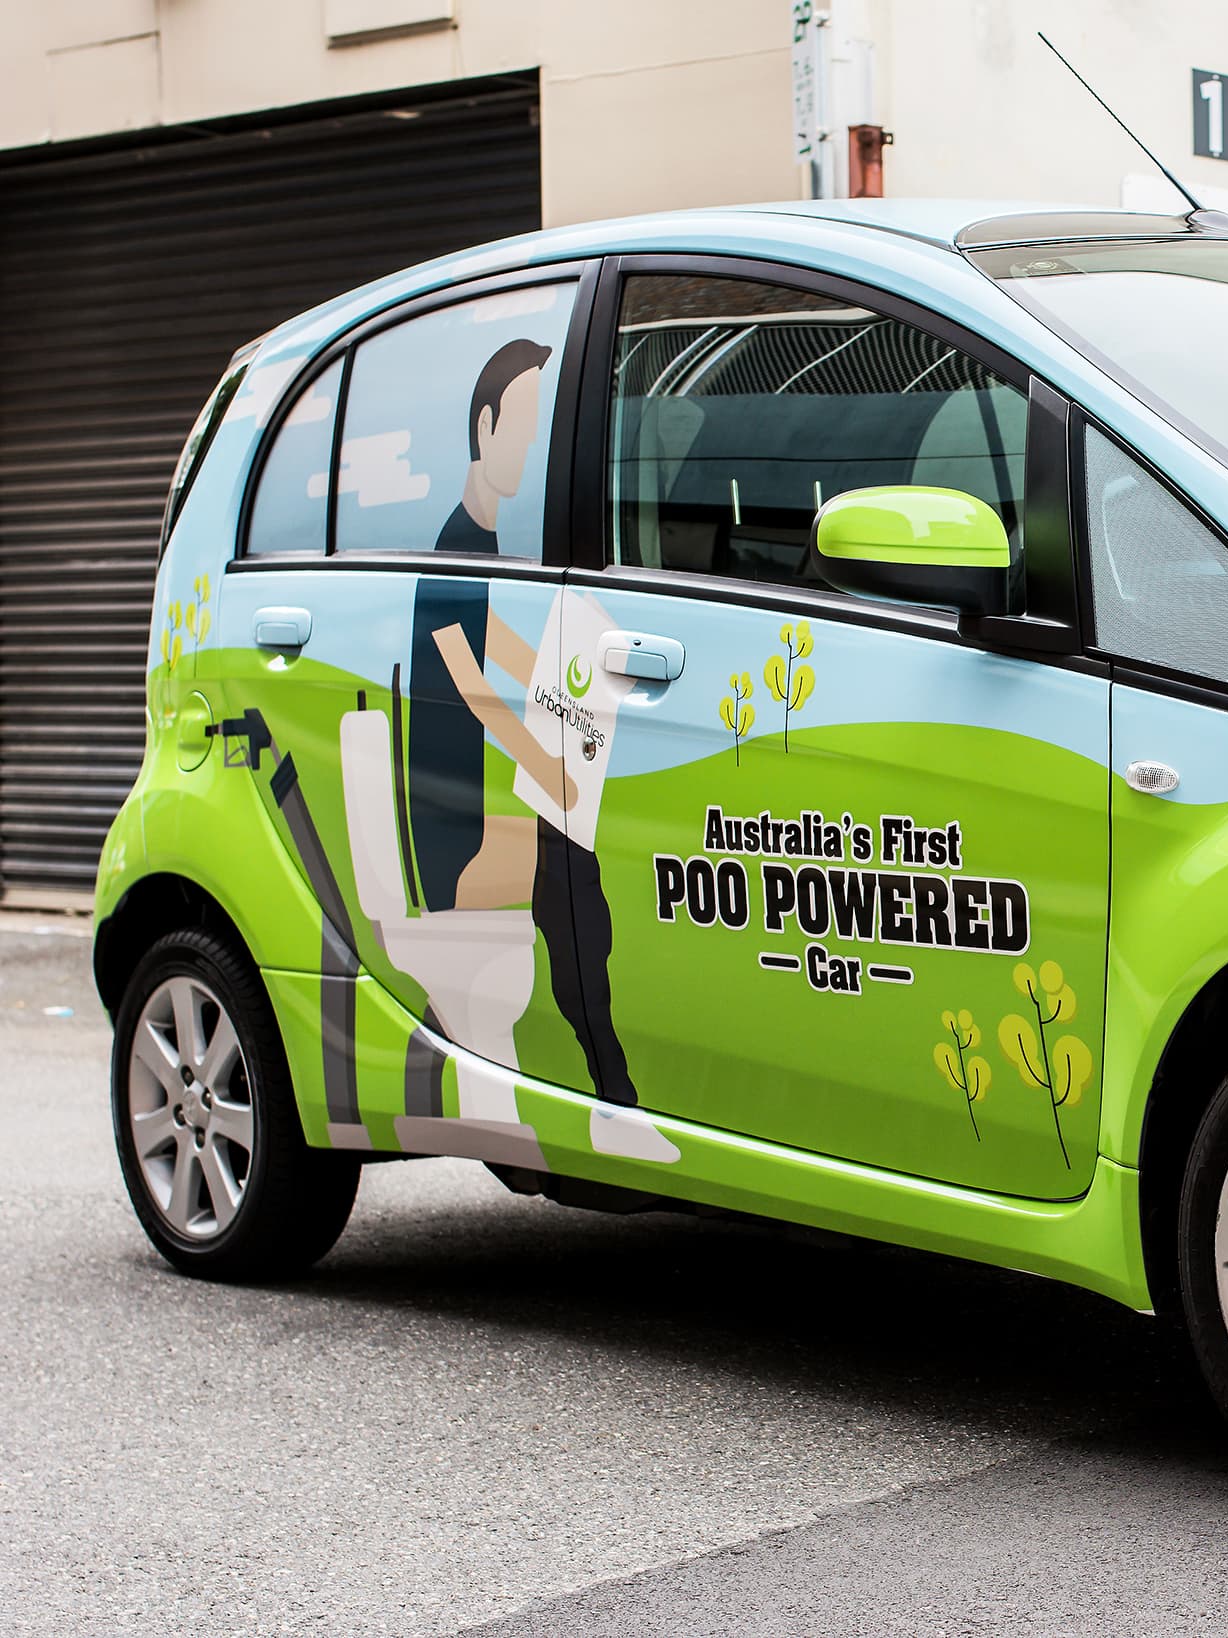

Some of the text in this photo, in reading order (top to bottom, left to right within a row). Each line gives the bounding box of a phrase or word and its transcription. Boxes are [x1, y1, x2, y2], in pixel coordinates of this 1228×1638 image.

[1200, 80, 1223, 153] 1
[704, 804, 962, 869] Australia's First
[654, 854, 1031, 956] POO POWERED
[805, 943, 862, 995] Car
